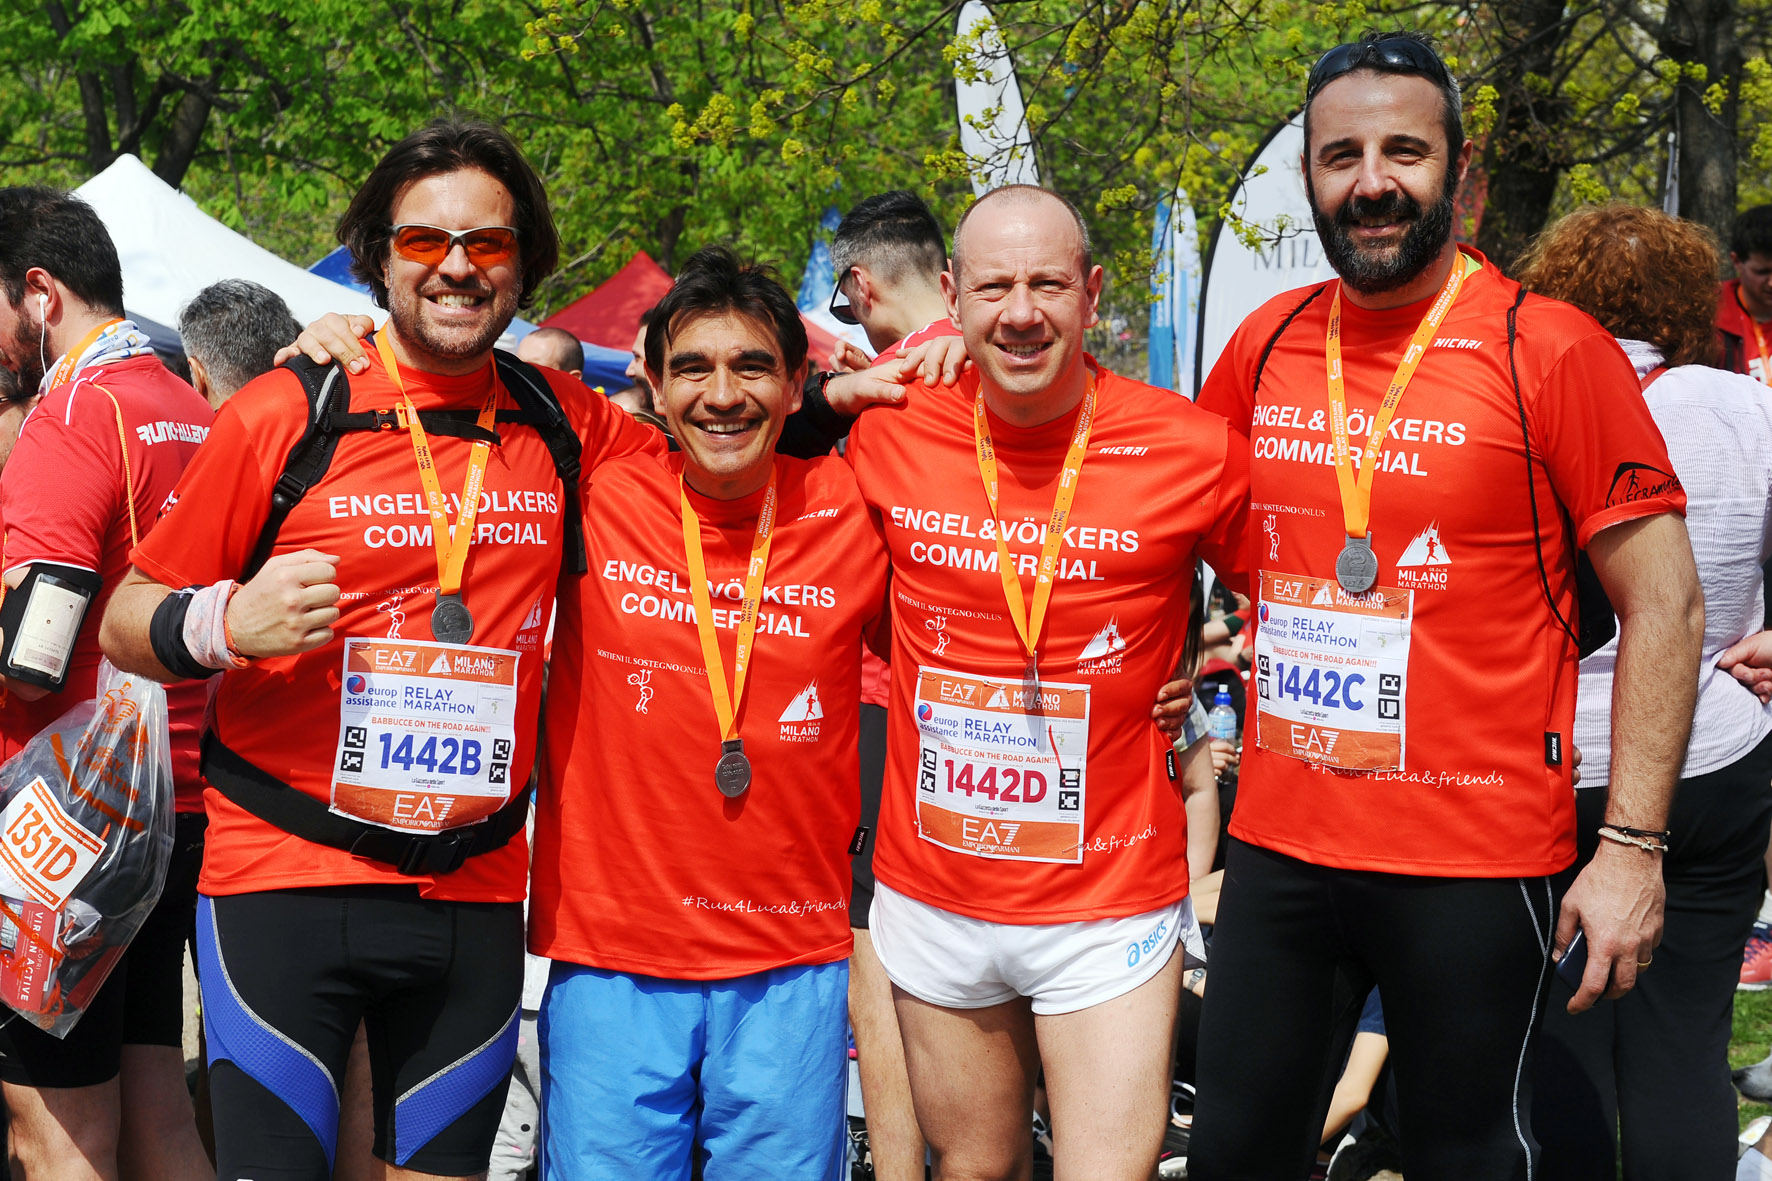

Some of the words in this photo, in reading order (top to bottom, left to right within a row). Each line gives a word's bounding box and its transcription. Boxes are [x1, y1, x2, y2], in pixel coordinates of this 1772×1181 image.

[1253, 239, 1322, 270] MIL
[1427, 290, 1448, 322] MARATHON
[1430, 294, 1451, 327] ASSISTANCE
[1253, 405, 1466, 445] ENGEL&ÖLKERS
[1332, 400, 1340, 436] ASSISTANCE
[1338, 402, 1346, 439] MARATHON
[1074, 412, 1086, 444] MARATHON
[1078, 416, 1091, 449] ASSISTANCE
[467, 464, 478, 497] ASSISTANCE
[429, 492, 438, 506] EA7
[467, 500, 475, 518] RELAY
[472, 468, 482, 500] MARATHON
[758, 505, 768, 534] MARATHON
[1298, 507, 1325, 517] ONLUS
[762, 508, 773, 538] ASSISTANCE
[910, 542, 1104, 580] COMMRIAL
[602, 560, 836, 608] ENGELVÖKERS
[1398, 569, 1447, 582] MILANO
[1274, 579, 1303, 598] EA7
[1336, 587, 1384, 603] MILANO
[1398, 580, 1447, 591] MARATHON
[920, 602, 927, 610] IL
[928, 605, 972, 618] SOSTEGNO
[973, 612, 1002, 621] ONLUS
[1336, 599, 1383, 610] MARATHON
[1270, 617, 1288, 627] europ
[1293, 617, 1334, 633] RELAY
[1292, 630, 1357, 648] MARATHON
[375, 650, 417, 668] EA7
[454, 655, 494, 670] MILANO
[597, 649, 624, 663] SOSTIENI
[625, 656, 632, 664] IL
[633, 658, 680, 672] SOSTEGNO
[680, 665, 708, 676] ONLUS
[1077, 658, 1122, 668] MILANO
[1300, 650, 1309, 659] ON
[1311, 653, 1322, 662] THE
[1324, 654, 1343, 664] ROAD
[454, 666, 494, 677] MARATHON
[1077, 667, 1122, 675] MARATHON
[368, 687, 398, 698] europ
[404, 686, 453, 700] RELAY
[940, 681, 976, 701] EA7
[1276, 662, 1366, 711] 1442C
[346, 696, 397, 708] assistance
[404, 699, 475, 715] MARATHON
[1013, 691, 1060, 704] MANO
[1013, 701, 1060, 711] MAATHON
[372, 717, 413, 727] BABBUCCE
[415, 720, 425, 728] ON
[427, 721, 441, 729] THE
[443, 722, 462, 731] ROAD
[780, 724, 820, 736] MILANO
[919, 723, 958, 738] assistance
[934, 716, 958, 728] europ
[965, 718, 1012, 734] RELAY
[965, 731, 1036, 748] MARATHON
[1291, 724, 1340, 755] EA7
[379, 732, 482, 776] 1442B
[940, 743, 973, 757] BABBUCCE
[974, 751, 985, 759] ON
[987, 752, 1000, 761] THE
[1003, 754, 1024, 763] ROAD
[1026, 756, 1057, 765] AGAIN!!!
[945, 759, 1047, 803] 1442D
[393, 794, 456, 820] EA7
[962, 818, 1021, 845] EA7
[6, 802, 77, 882] 1351D
[998, 845, 1020, 853] ARMANI
[682, 895, 846, 917] #Run4Luca&friends
[29, 912, 44, 953] VIRGIN
[1142, 920, 1168, 954] asics
[35, 948, 44, 970] COPRI
[20, 957, 35, 1002] ACTIVE
